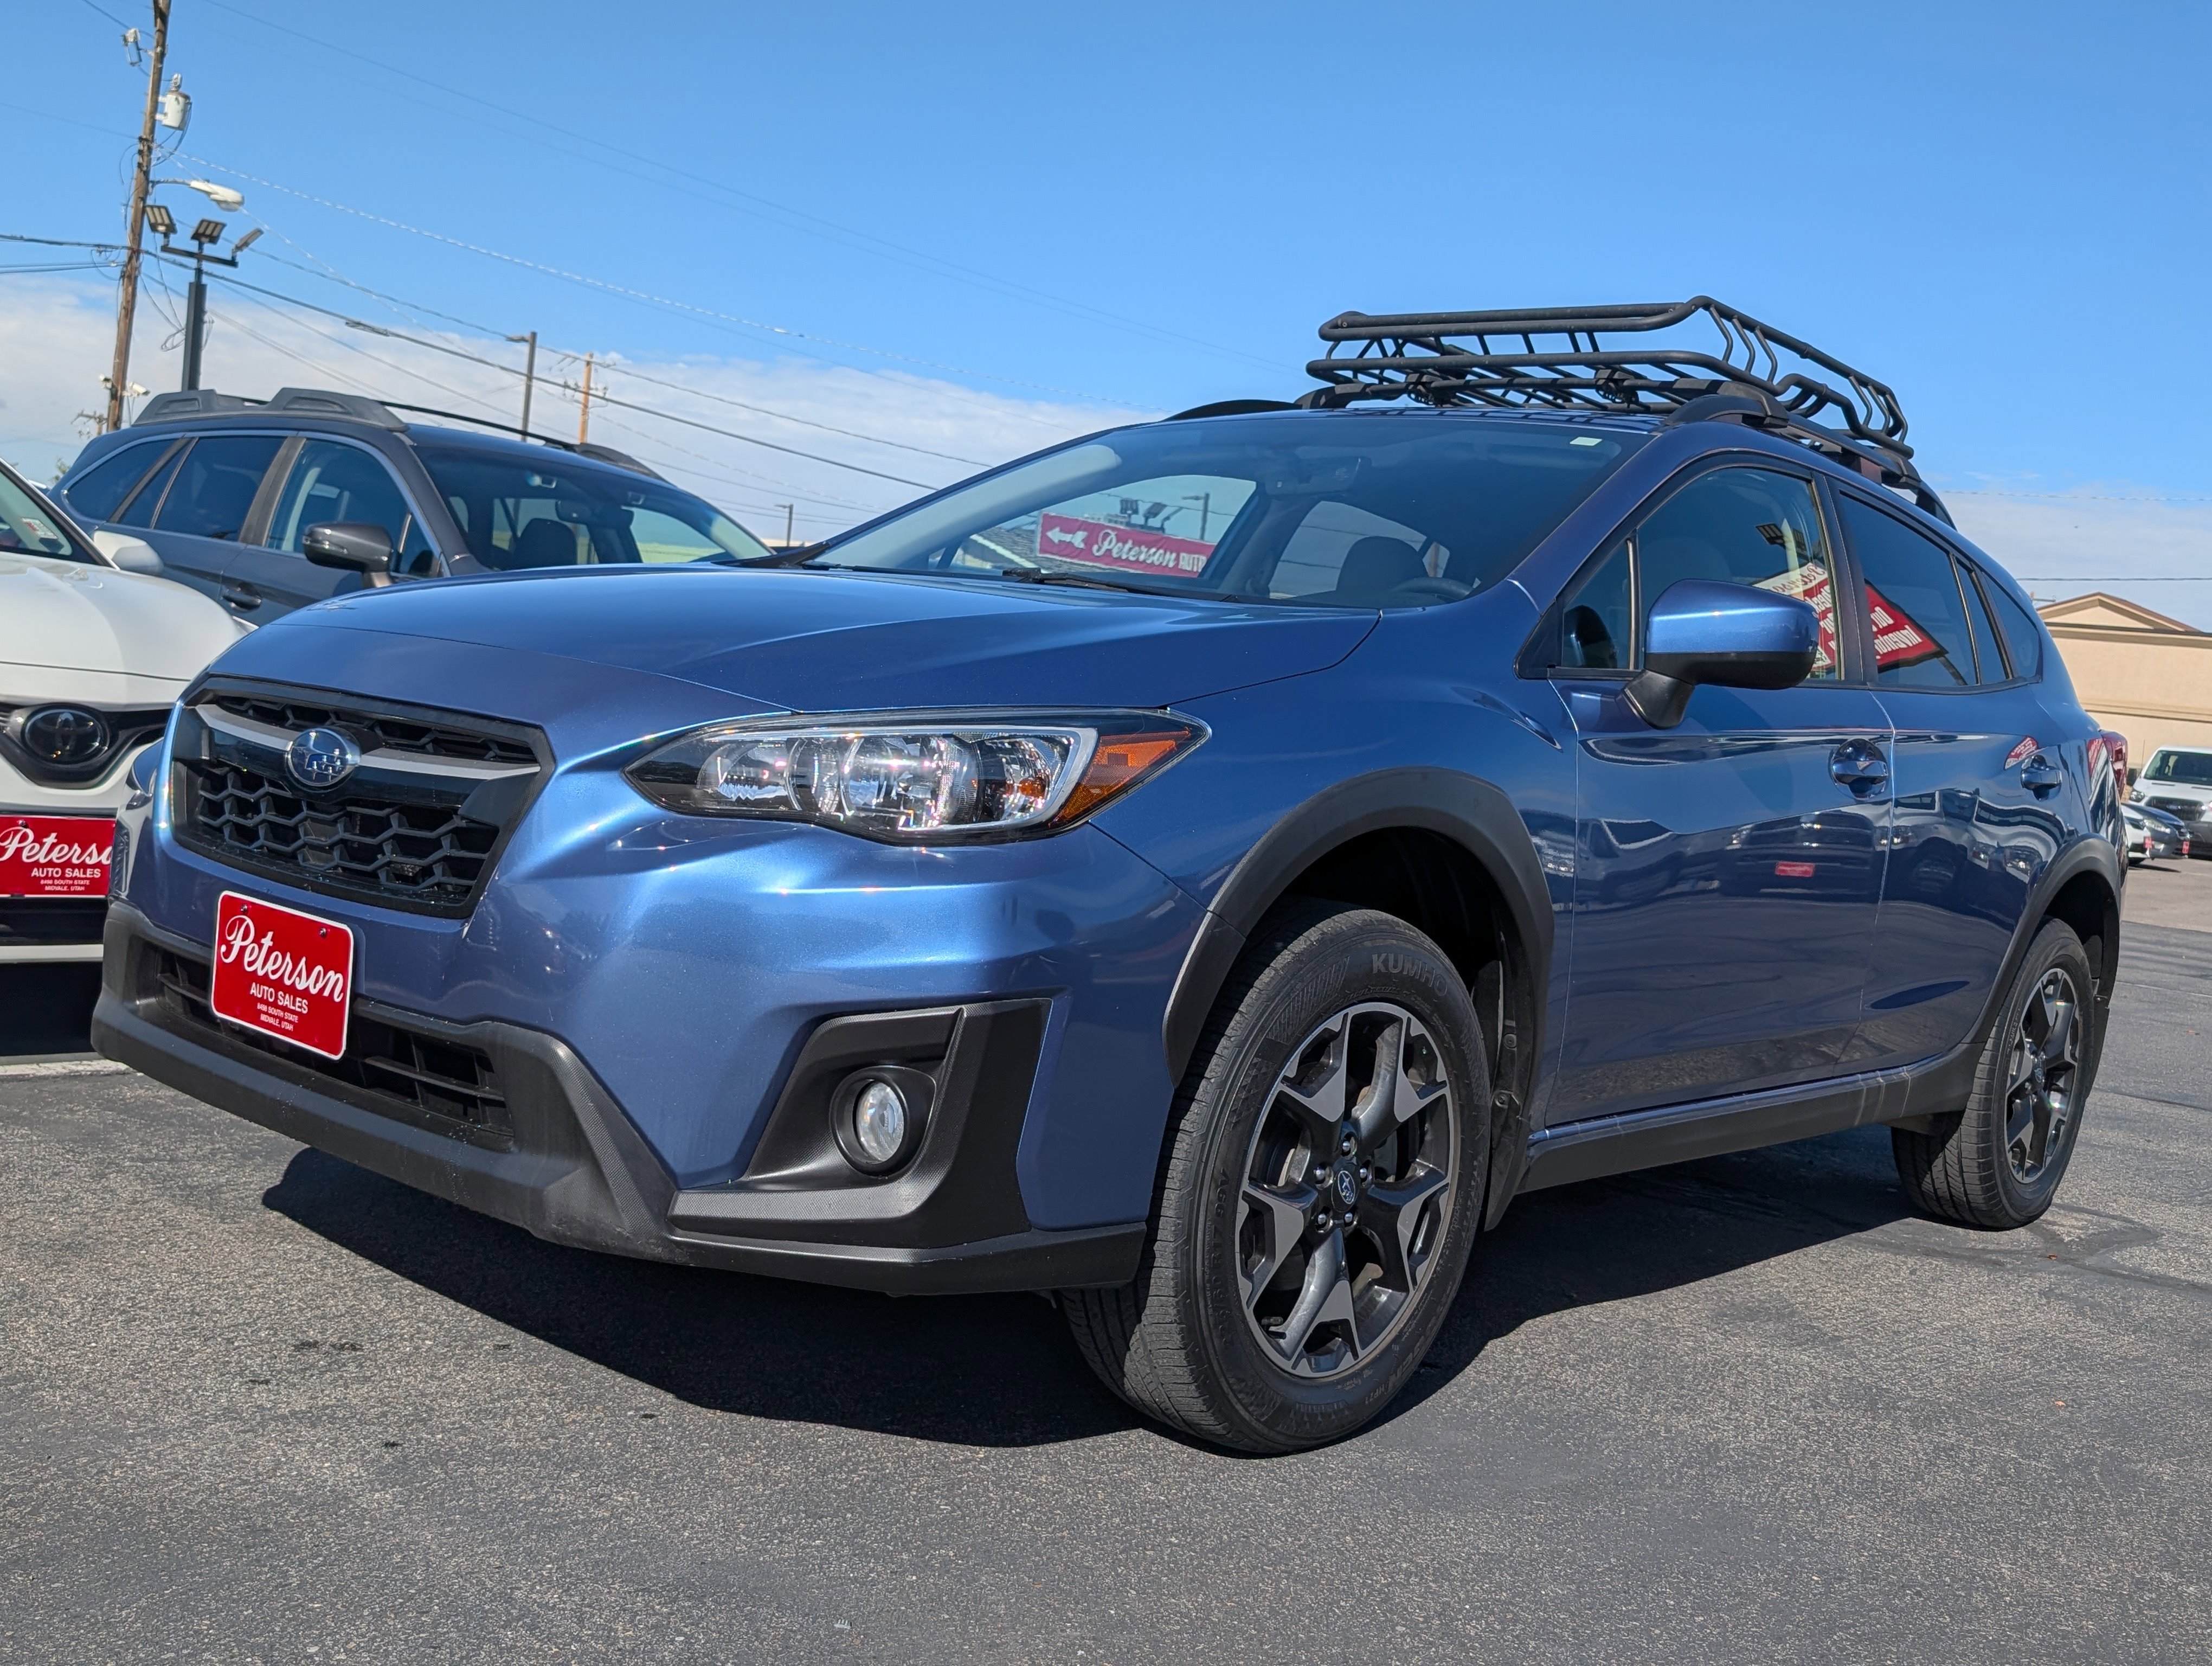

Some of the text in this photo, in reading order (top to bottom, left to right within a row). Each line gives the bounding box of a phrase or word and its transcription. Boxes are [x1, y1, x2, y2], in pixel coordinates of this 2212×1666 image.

[1092, 529, 1178, 568] Peterson
[0, 826, 112, 865] Peterso
[31, 867, 101, 879] AUTO SALES
[220, 915, 344, 1002] Peterson
[1372, 952, 1448, 997] KUMHO
[250, 982, 308, 1014] AUTO SALES
[268, 1006, 284, 1020] SOUTH
[285, 1010, 299, 1023] STATE
[281, 1020, 294, 1031] UTAH
[1214, 1167, 1230, 1219] 99V
[1210, 1224, 1223, 1268] R17
[1365, 1382, 1386, 1405] HP71
